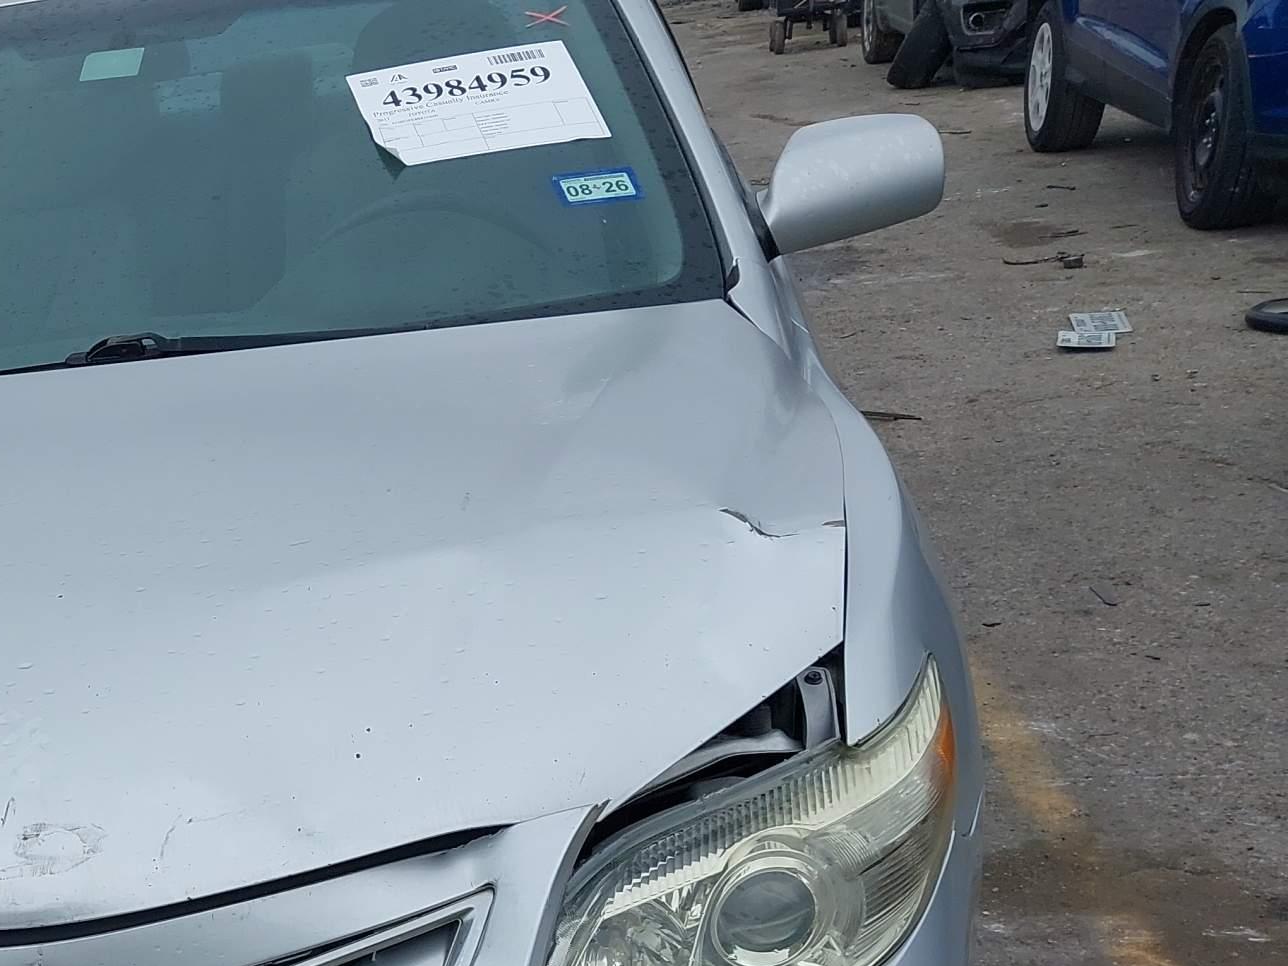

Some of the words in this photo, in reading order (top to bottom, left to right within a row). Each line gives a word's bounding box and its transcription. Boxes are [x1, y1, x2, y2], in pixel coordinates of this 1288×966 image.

[383, 66, 550, 107] 43984959
[373, 103, 424, 117] Progressive
[466, 89, 509, 101] Insurance
[408, 109, 436, 117] TOYOTA
[566, 184, 592, 197] 08
[602, 180, 629, 193] 26
